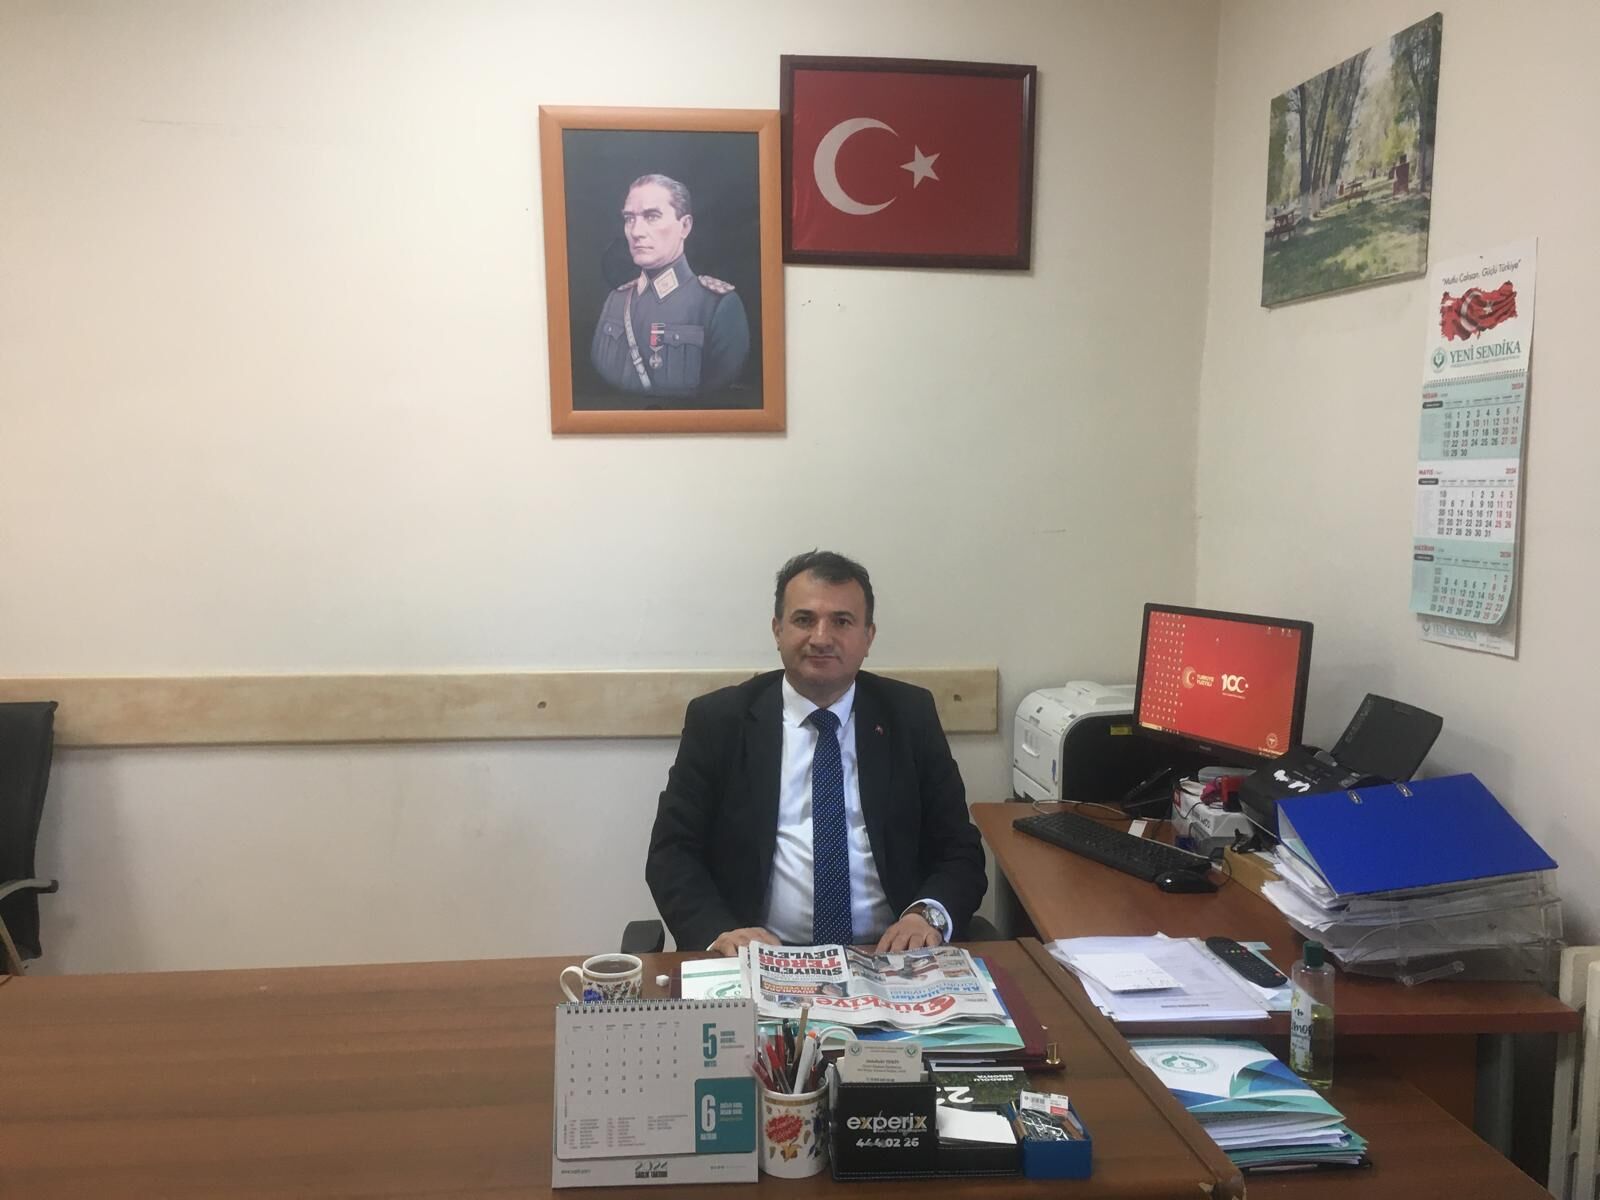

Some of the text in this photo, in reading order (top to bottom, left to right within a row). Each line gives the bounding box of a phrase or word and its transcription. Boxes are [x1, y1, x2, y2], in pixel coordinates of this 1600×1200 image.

[1450, 344, 1474, 363] YENİ
[1476, 339, 1521, 360] SENDİKA
[703, 1023, 717, 1059] 5
[701, 1094, 716, 1132] 6
[846, 1110, 927, 1133] experix
[886, 1138, 900, 1148] 02
[904, 1138, 919, 1148] 26
